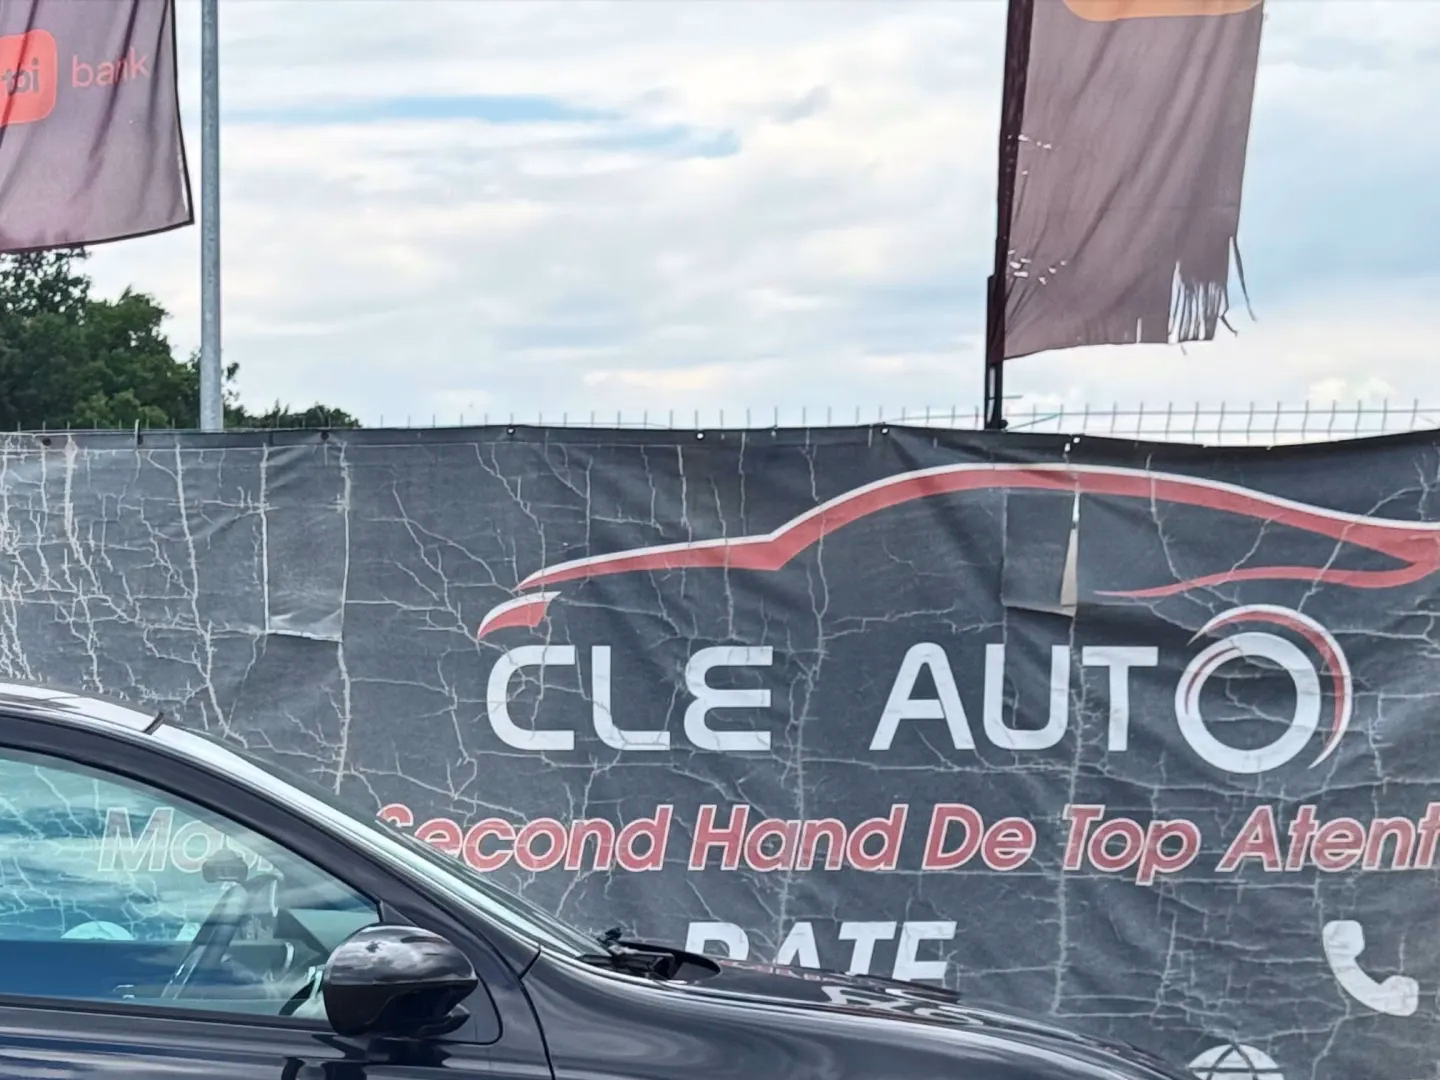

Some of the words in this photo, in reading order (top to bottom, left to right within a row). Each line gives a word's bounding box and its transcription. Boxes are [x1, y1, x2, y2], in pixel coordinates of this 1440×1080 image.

[72, 46, 151, 88] bank
[486, 644, 774, 752] CLE
[869, 630, 1323, 775] AUTO
[687, 803, 907, 872] Hand
[922, 804, 1037, 872] De
[1062, 803, 1202, 886] Top
[1215, 802, 1440, 873] Atent
